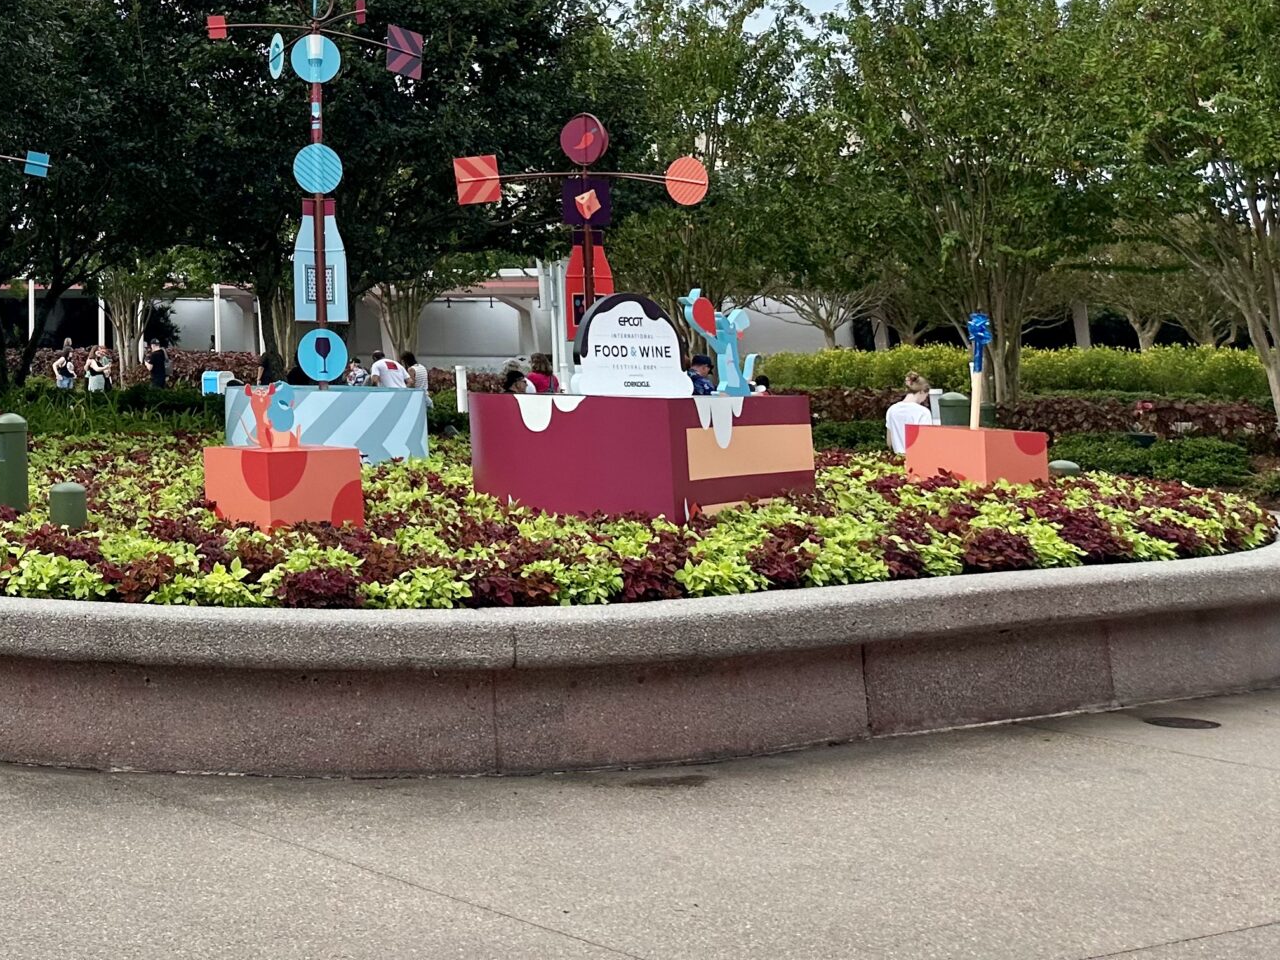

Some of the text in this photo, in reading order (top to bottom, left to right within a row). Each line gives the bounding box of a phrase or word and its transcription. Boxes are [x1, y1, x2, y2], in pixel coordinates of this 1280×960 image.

[618, 317, 643, 326] EPCOT
[594, 345, 672, 358] FOOD & WINE
